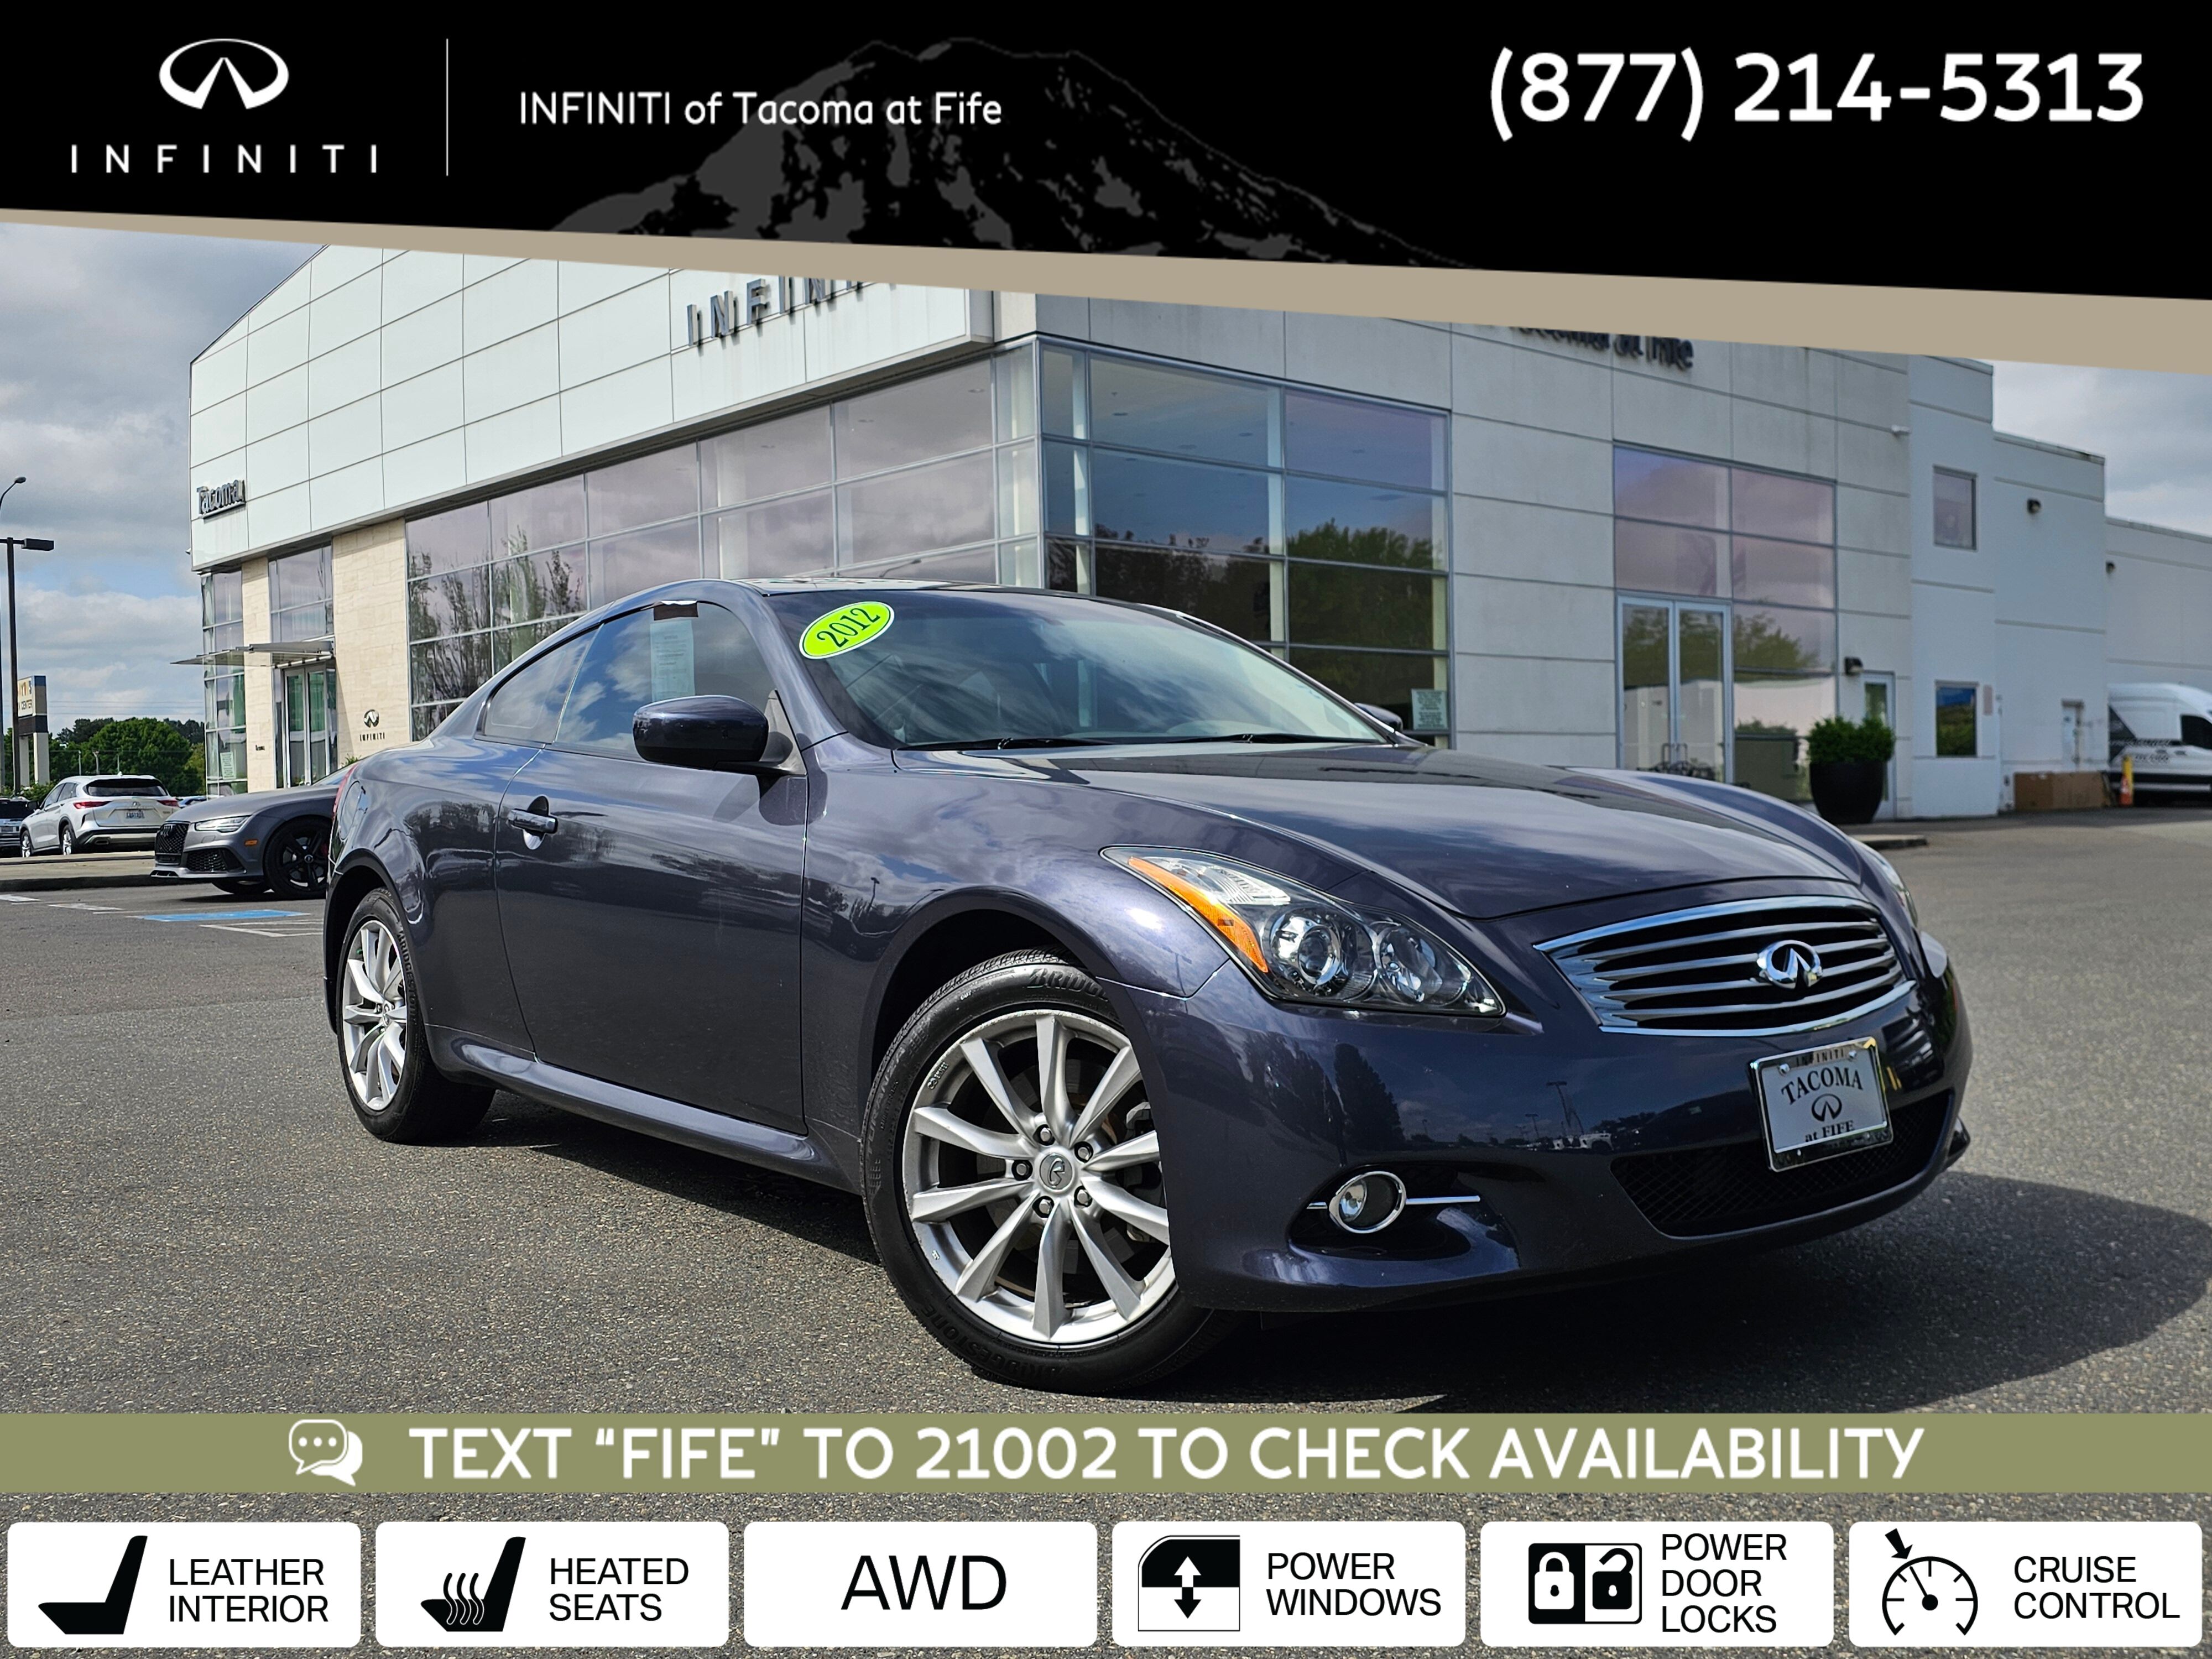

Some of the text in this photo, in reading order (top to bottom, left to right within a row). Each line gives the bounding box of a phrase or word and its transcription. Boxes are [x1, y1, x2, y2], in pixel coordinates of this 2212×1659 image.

[196, 479, 244, 514] Tacoma
[817, 608, 881, 648] 2012
[1782, 1066, 1864, 1105] TACOMA
[1805, 1131, 1818, 1142] at
[1822, 1120, 1855, 1138] FIFE
